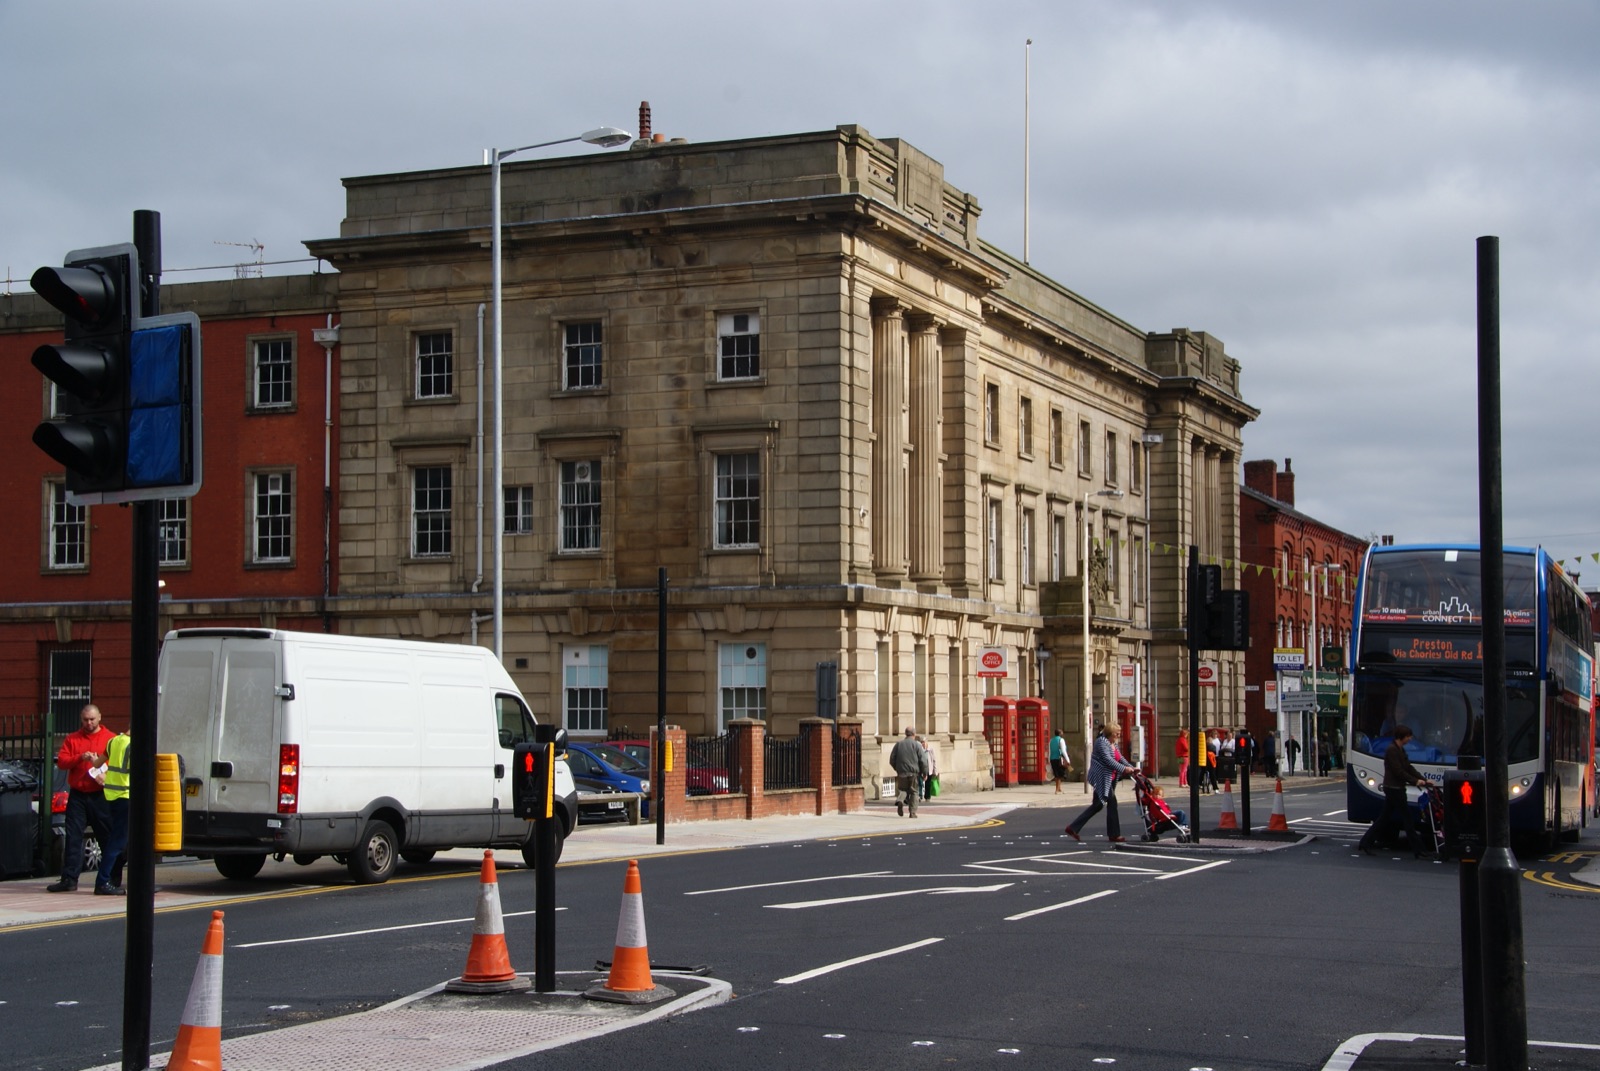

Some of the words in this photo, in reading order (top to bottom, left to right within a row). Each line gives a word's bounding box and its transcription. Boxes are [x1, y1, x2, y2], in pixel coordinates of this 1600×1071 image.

[1422, 615, 1463, 623] CONNECT
[1413, 638, 1453, 650] Preston
[1393, 649, 1406, 658] Via
[1409, 650, 1442, 659] Chorley
[1445, 650, 1458, 659] Old
[1461, 651, 1473, 660] Rd
[1423, 771, 1444, 782] Stag
